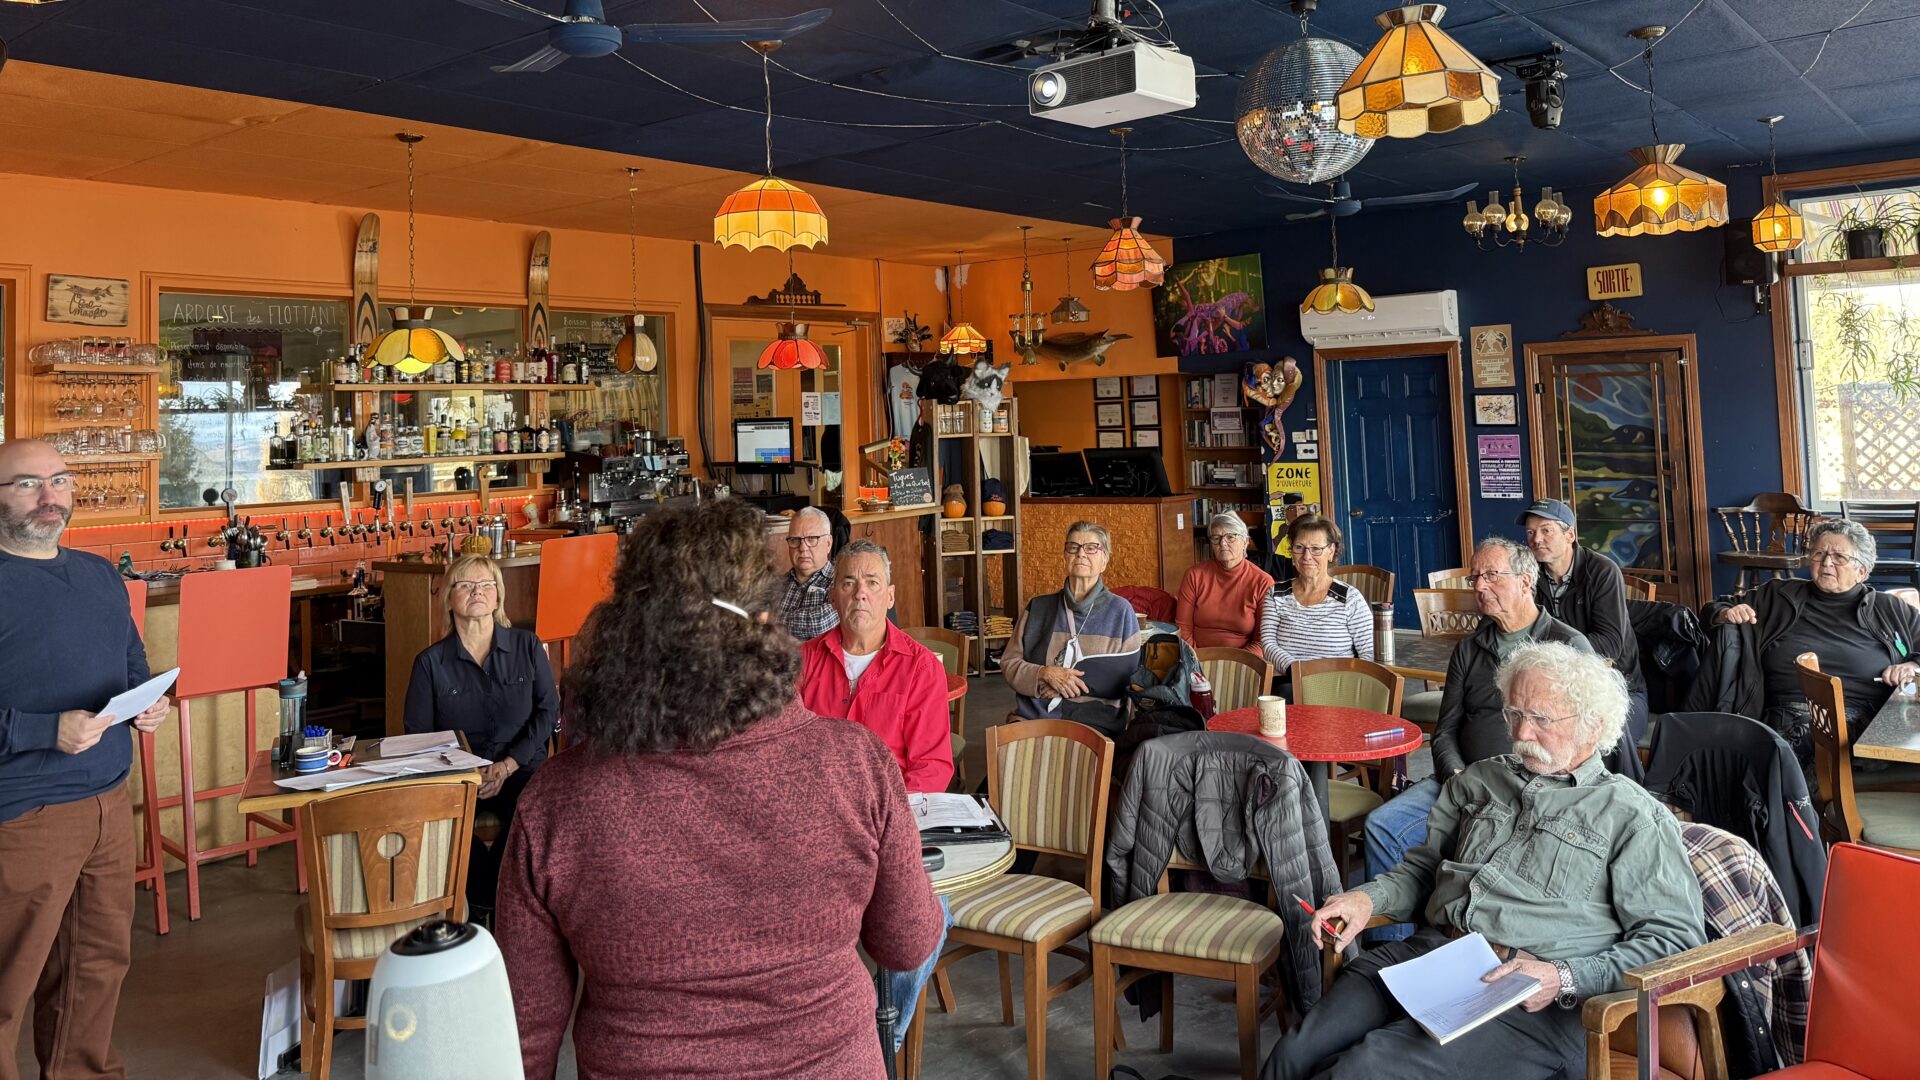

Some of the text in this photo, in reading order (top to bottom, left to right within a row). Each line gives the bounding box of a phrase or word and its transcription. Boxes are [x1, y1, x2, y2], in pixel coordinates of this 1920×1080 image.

[1596, 267, 1631, 294] SORTIE
[173, 303, 239, 324] ARDOISE
[246, 309, 263, 325] des
[1276, 467, 1312, 479] ZONE
[1276, 480, 1312, 488] D'OUVERTURE
